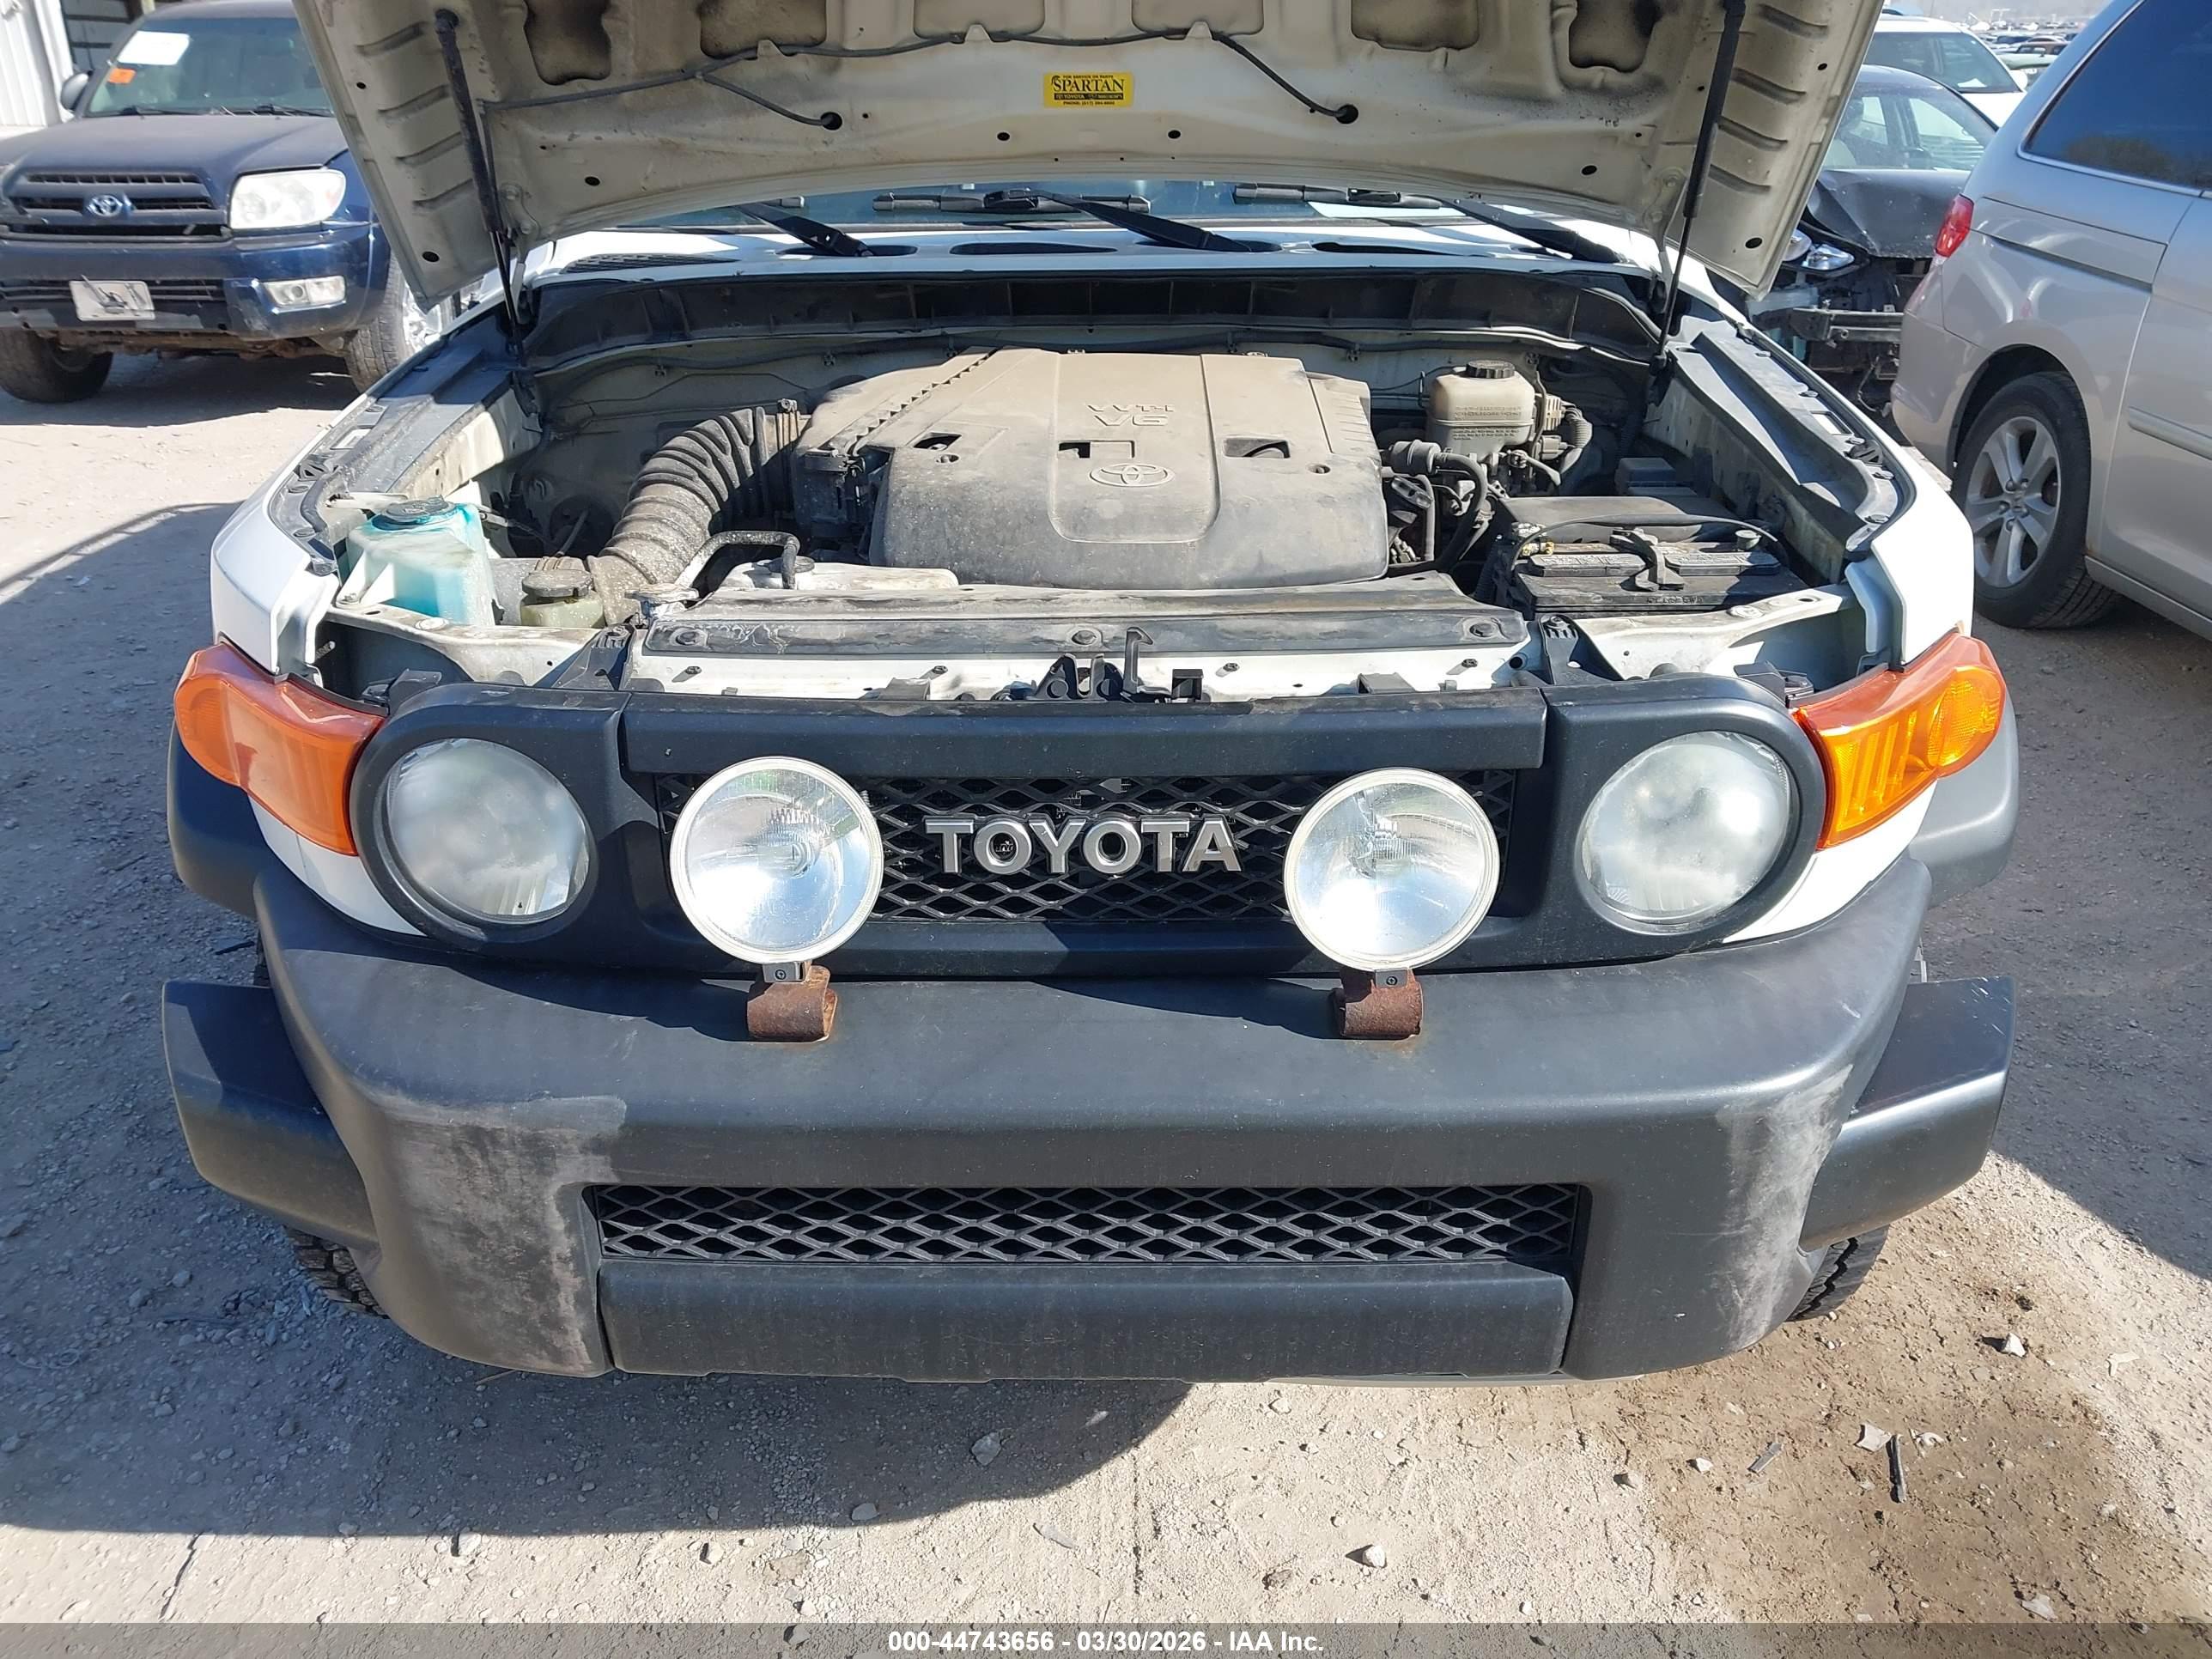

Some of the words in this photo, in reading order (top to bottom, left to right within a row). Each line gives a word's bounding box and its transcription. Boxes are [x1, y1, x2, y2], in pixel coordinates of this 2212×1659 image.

[1052, 78, 1124, 92] SPARTAN
[1093, 414, 1168, 426] V6
[925, 817, 1242, 874] TOYOTA
